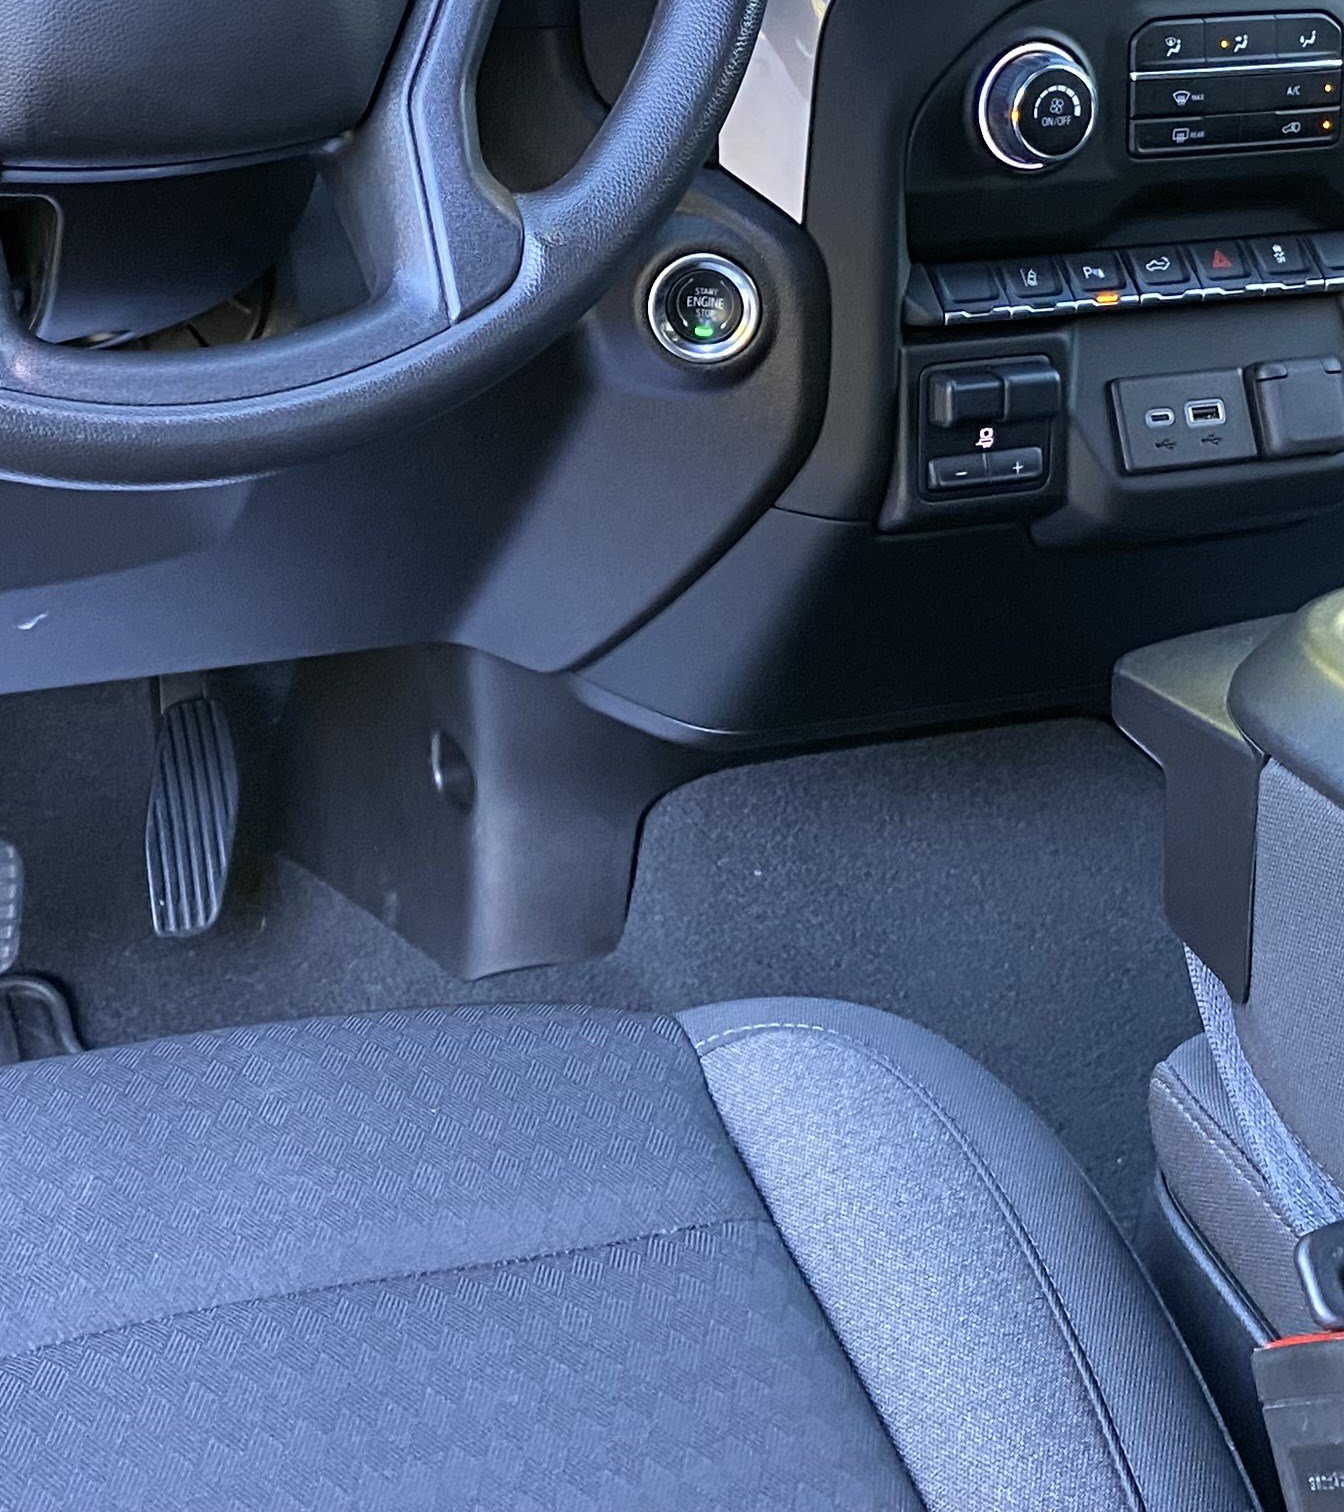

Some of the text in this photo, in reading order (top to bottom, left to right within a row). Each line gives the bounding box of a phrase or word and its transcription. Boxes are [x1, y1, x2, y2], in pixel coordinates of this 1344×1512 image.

[1286, 85, 1301, 96] A/C
[1041, 115, 1072, 127] ON/OFF
[694, 287, 719, 296] START
[686, 296, 724, 309] ENGINE
